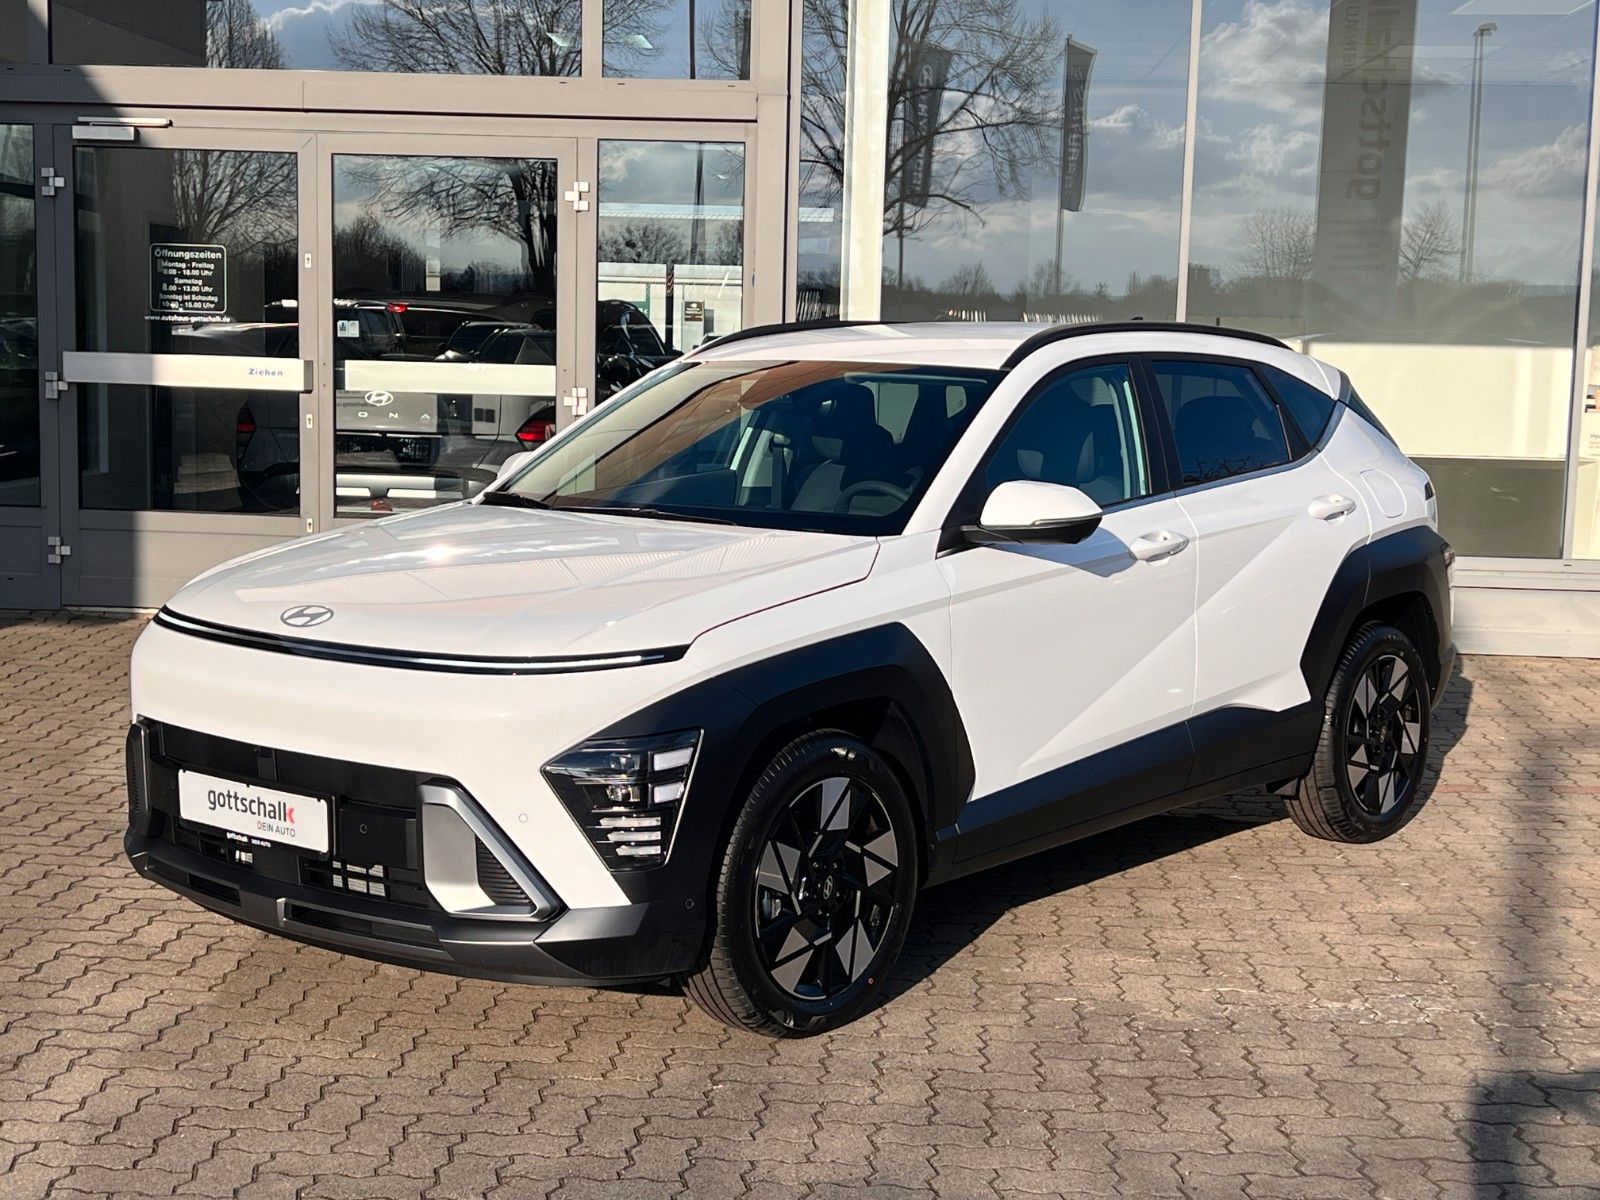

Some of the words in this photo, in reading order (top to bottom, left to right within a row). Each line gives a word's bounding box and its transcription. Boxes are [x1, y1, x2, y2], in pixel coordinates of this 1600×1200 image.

[155, 247, 222, 259] Öffnungszeiten
[161, 260, 186, 269] Montag
[191, 261, 215, 270] Freitag
[174, 277, 203, 285] Samstag
[249, 368, 283, 376] Ziehen
[357, 411, 431, 420] ONA
[208, 790, 295, 823] gottschalk
[257, 821, 273, 833] DEIN
[275, 825, 295, 837] AUTO
